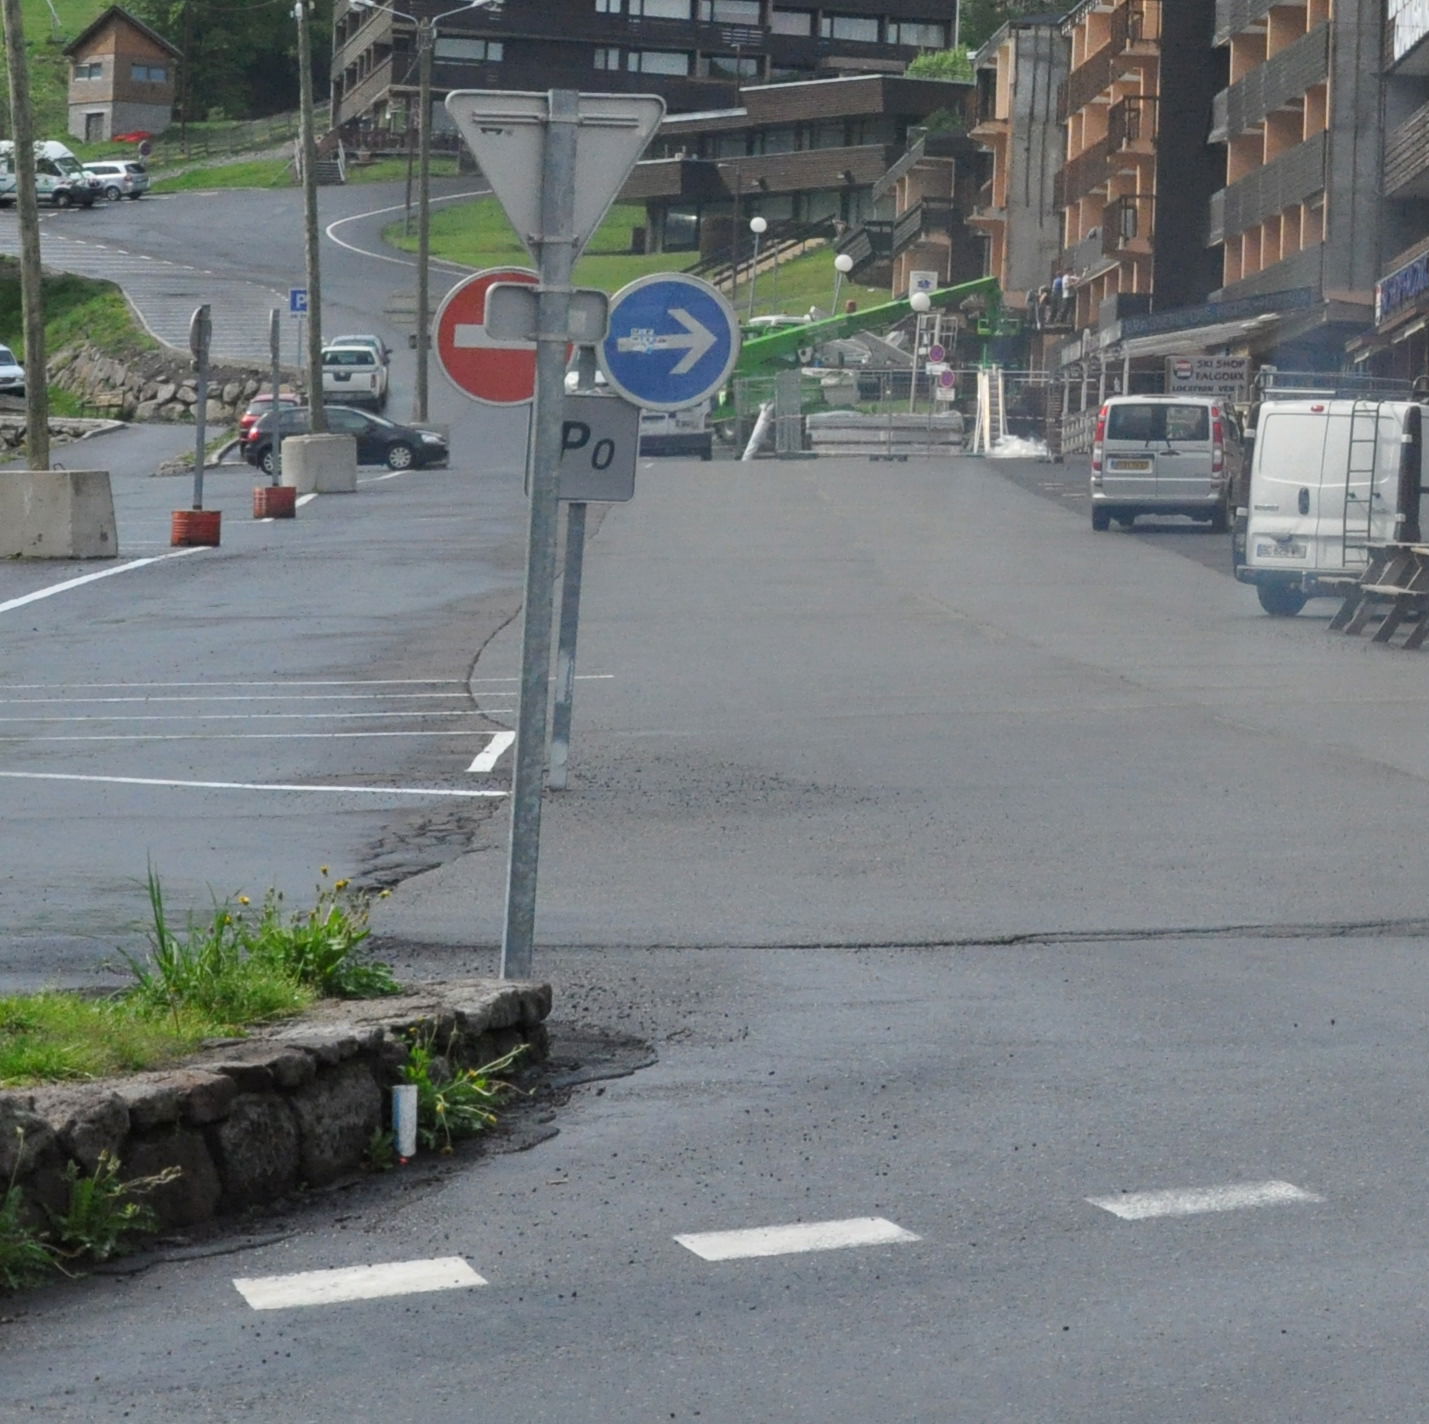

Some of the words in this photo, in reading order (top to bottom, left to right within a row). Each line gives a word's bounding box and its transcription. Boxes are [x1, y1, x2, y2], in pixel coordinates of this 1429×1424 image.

[1196, 359, 1214, 368] SKI
[1216, 359, 1246, 368] SHOP
[1194, 371, 1245, 381] FALGOUX
[1172, 384, 1214, 392] LOCATION
